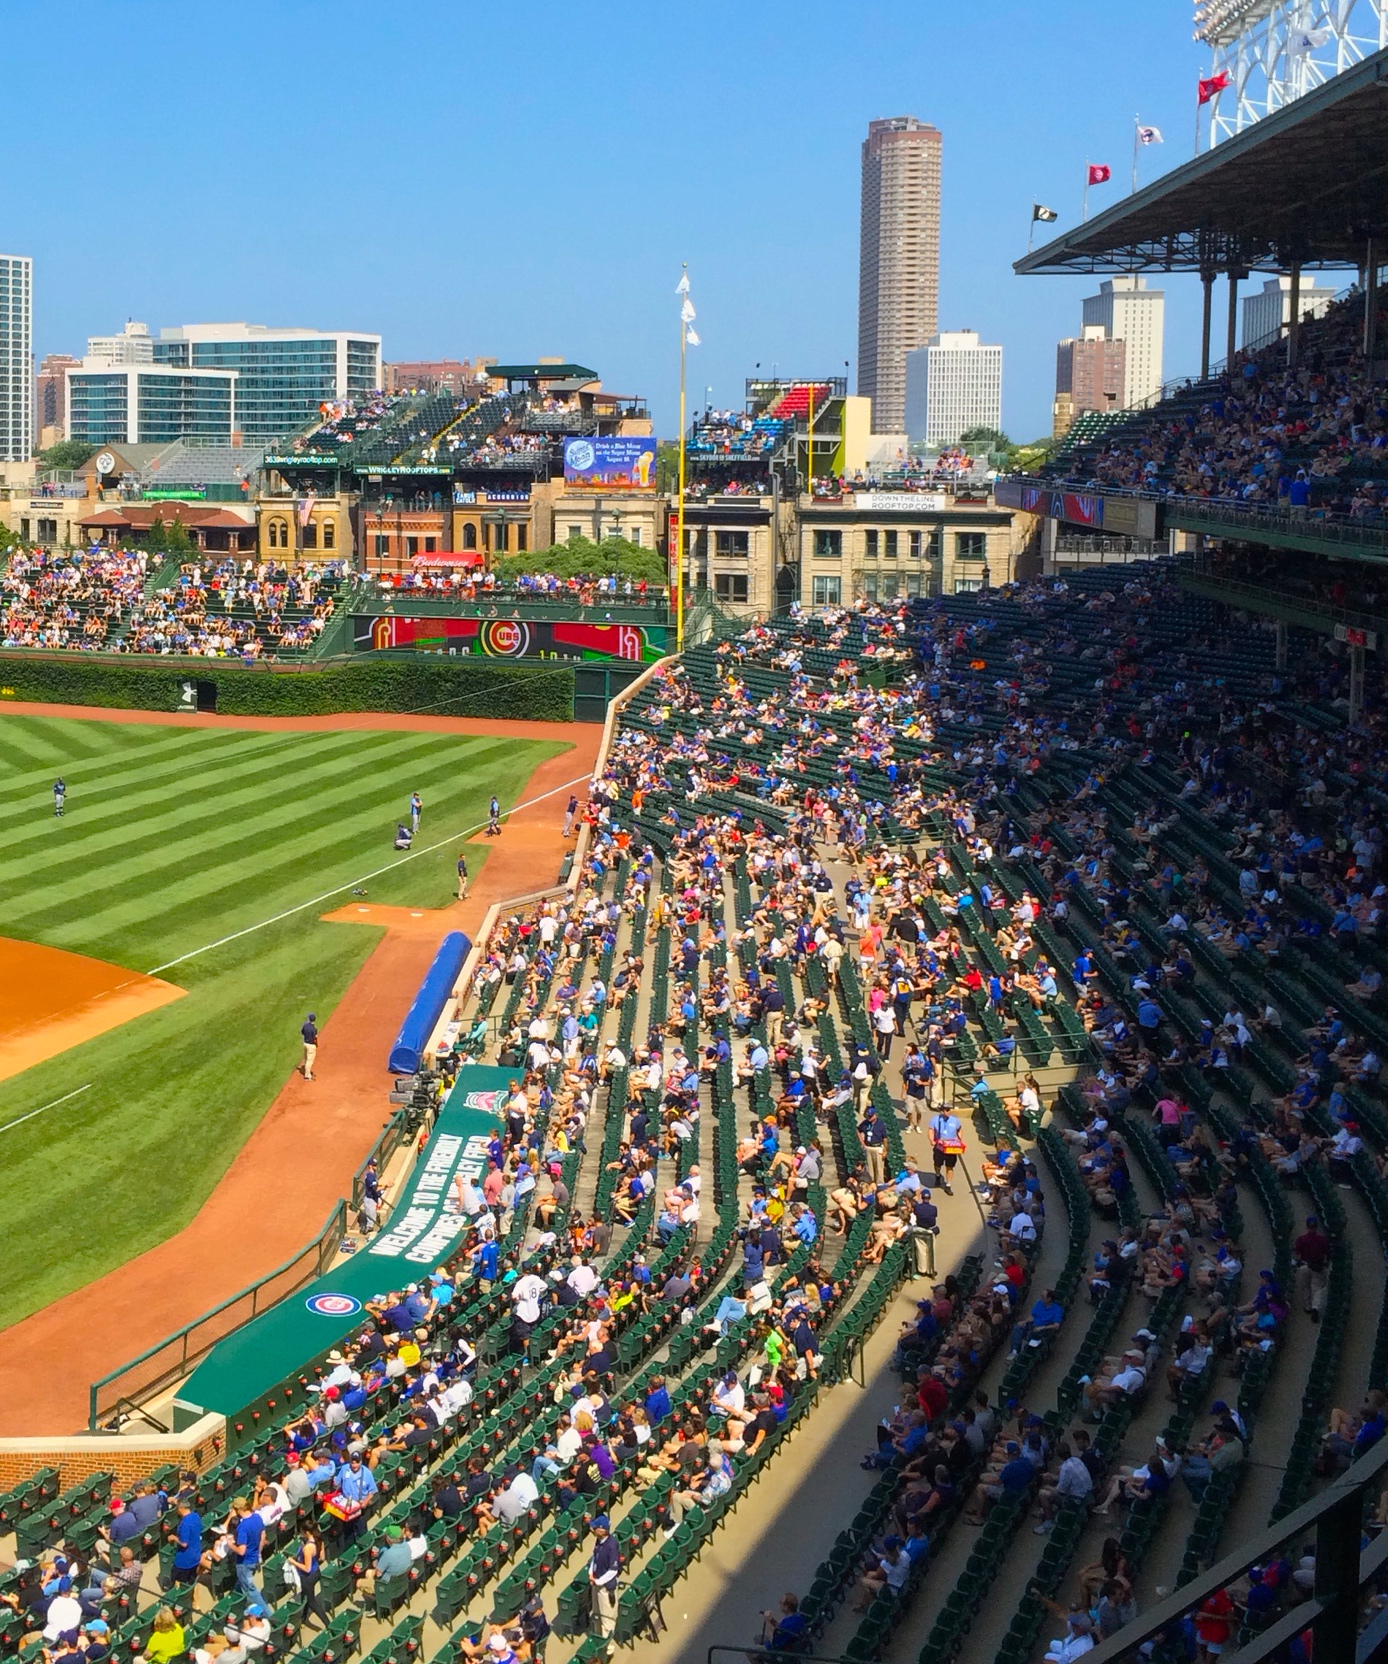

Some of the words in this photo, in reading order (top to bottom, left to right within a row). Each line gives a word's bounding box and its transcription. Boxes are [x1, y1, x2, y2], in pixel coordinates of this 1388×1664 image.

[413, 555, 470, 567] Budweiser
[424, 1133, 464, 1173] FRIENDLY
[416, 1172, 448, 1191] THE
[411, 1192, 440, 1205] TO
[368, 1206, 436, 1256] WELCOME
[404, 1214, 467, 1263] CONFINES
